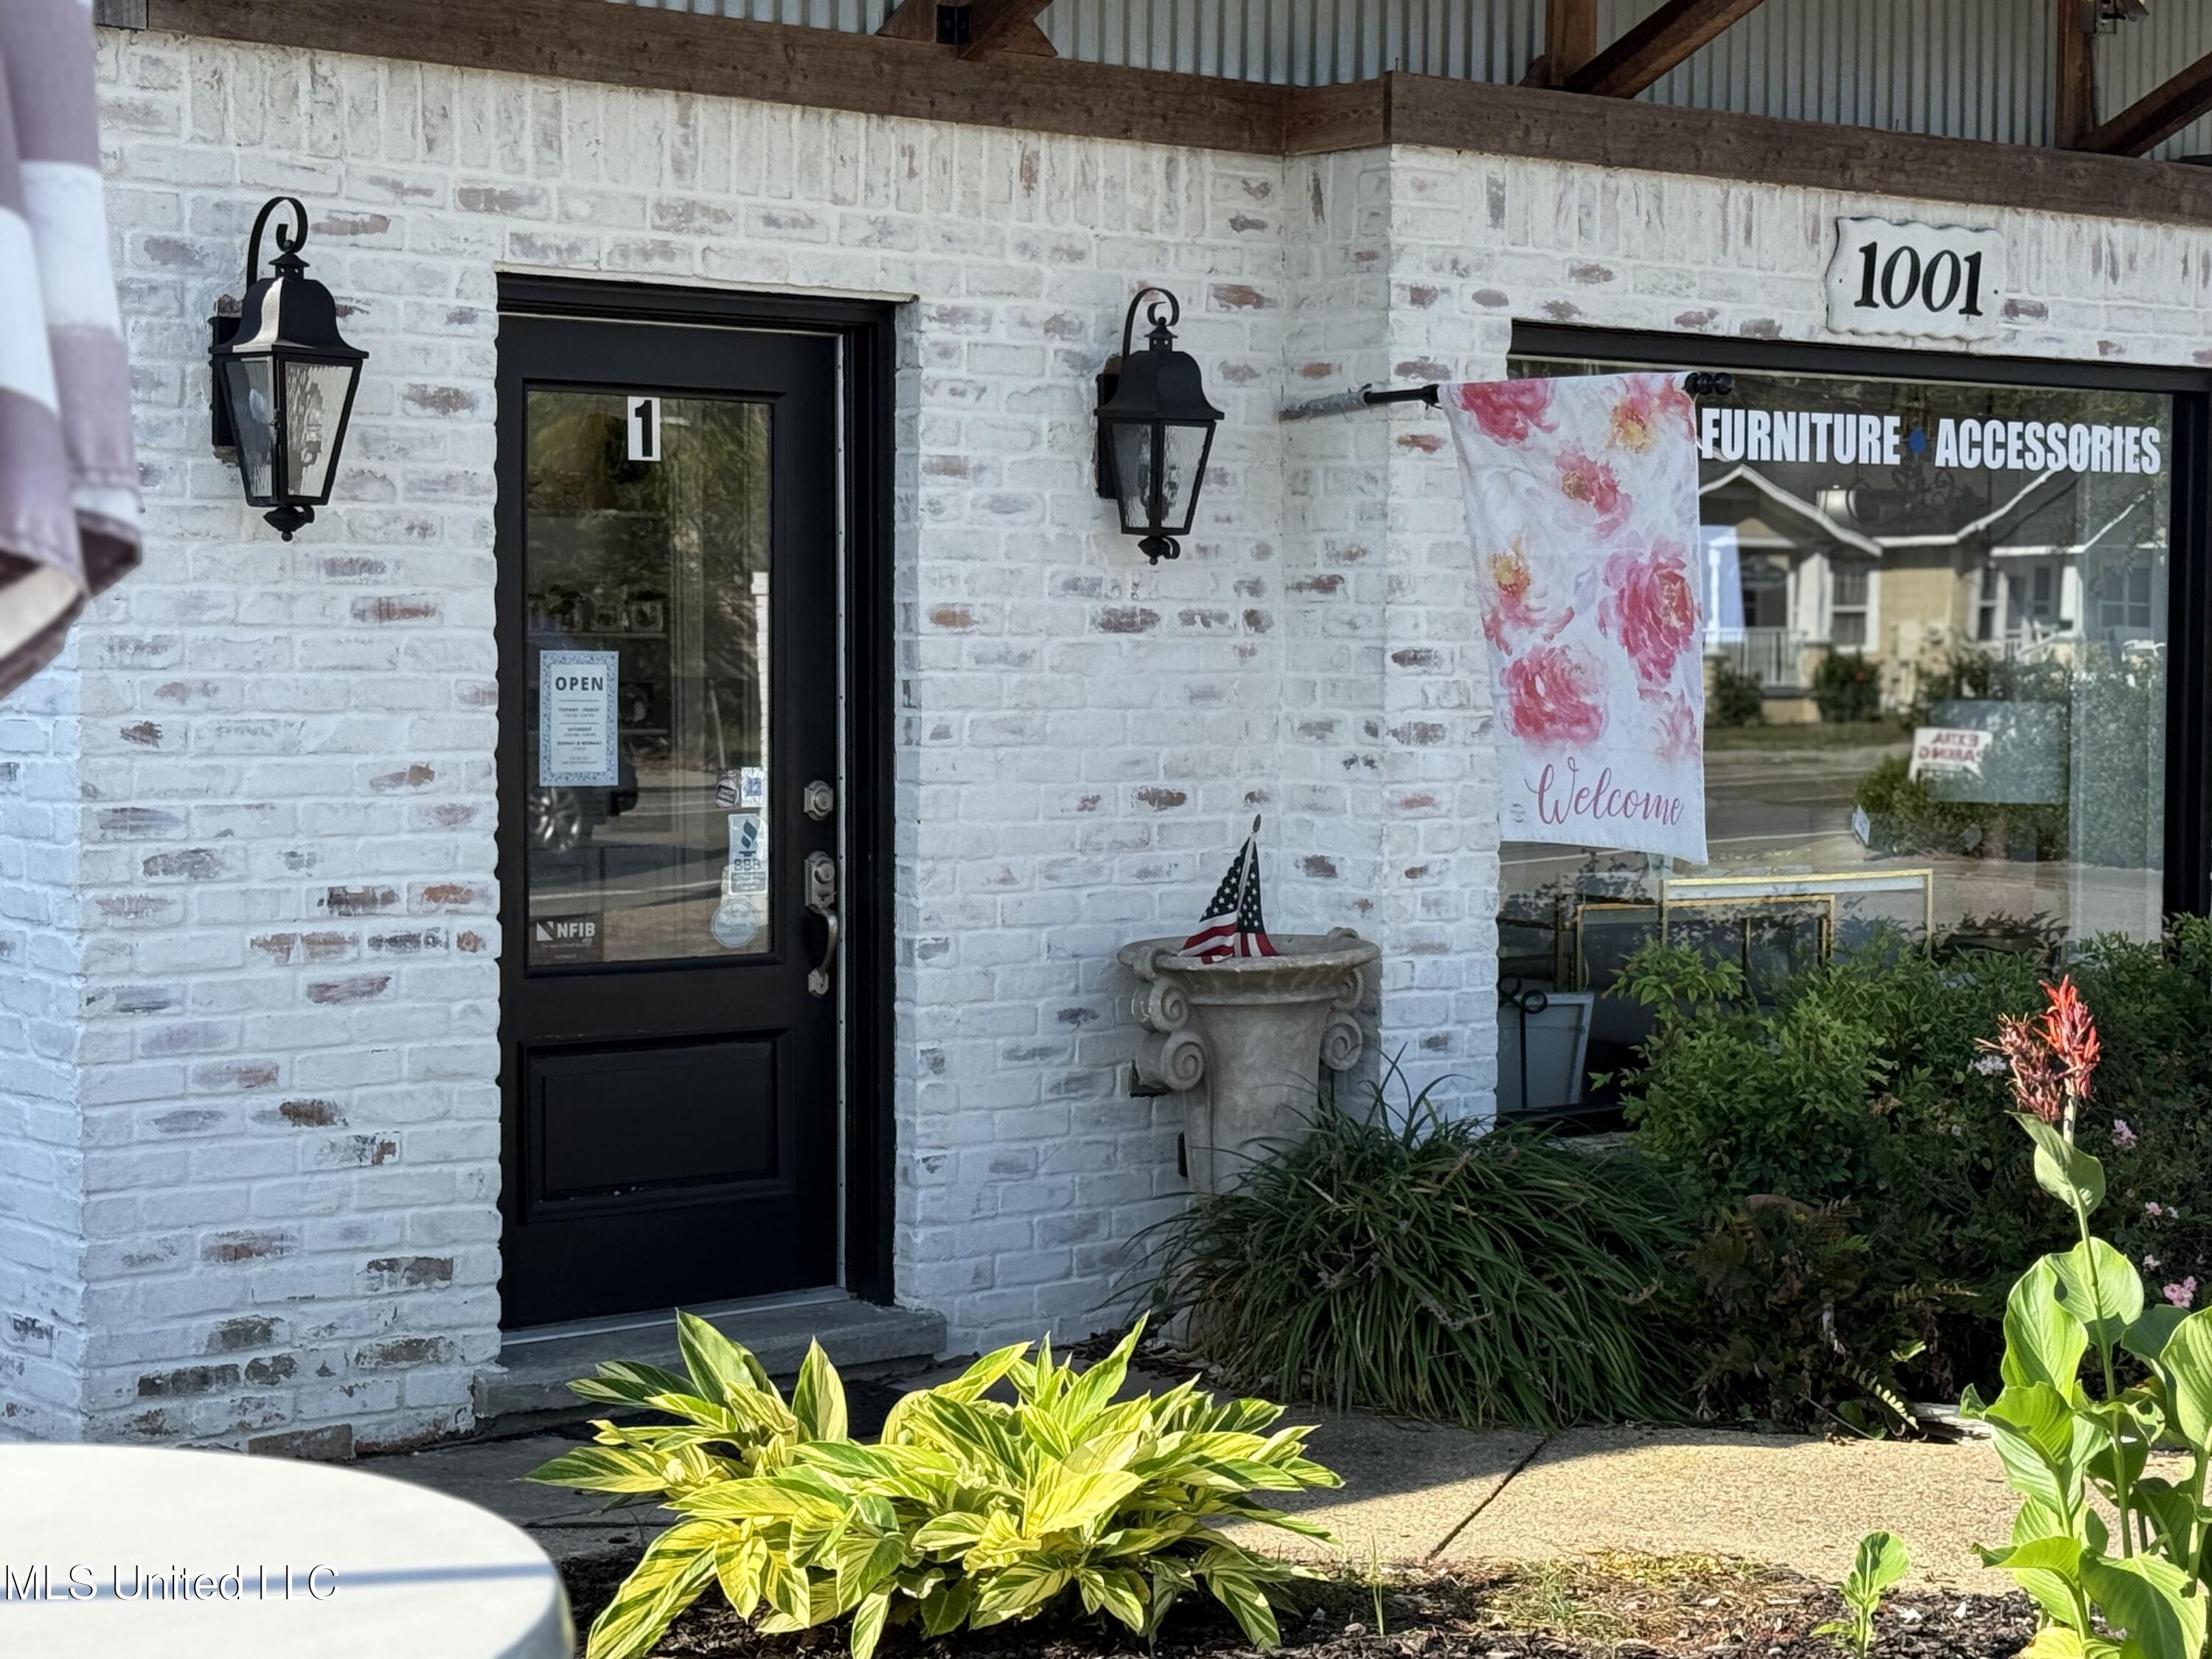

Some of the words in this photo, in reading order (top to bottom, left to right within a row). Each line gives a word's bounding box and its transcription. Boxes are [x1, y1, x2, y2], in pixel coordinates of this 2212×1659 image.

[1854, 240, 1983, 317] 1001
[634, 399, 653, 458] 1
[1700, 407, 1902, 466] FURNITURE
[1934, 417, 2162, 476] ACCESSORIES
[554, 676, 604, 692] OPEN
[1523, 756, 1685, 826] Welcome
[734, 858, 762, 872] BBB
[557, 922, 596, 938] NFIB
